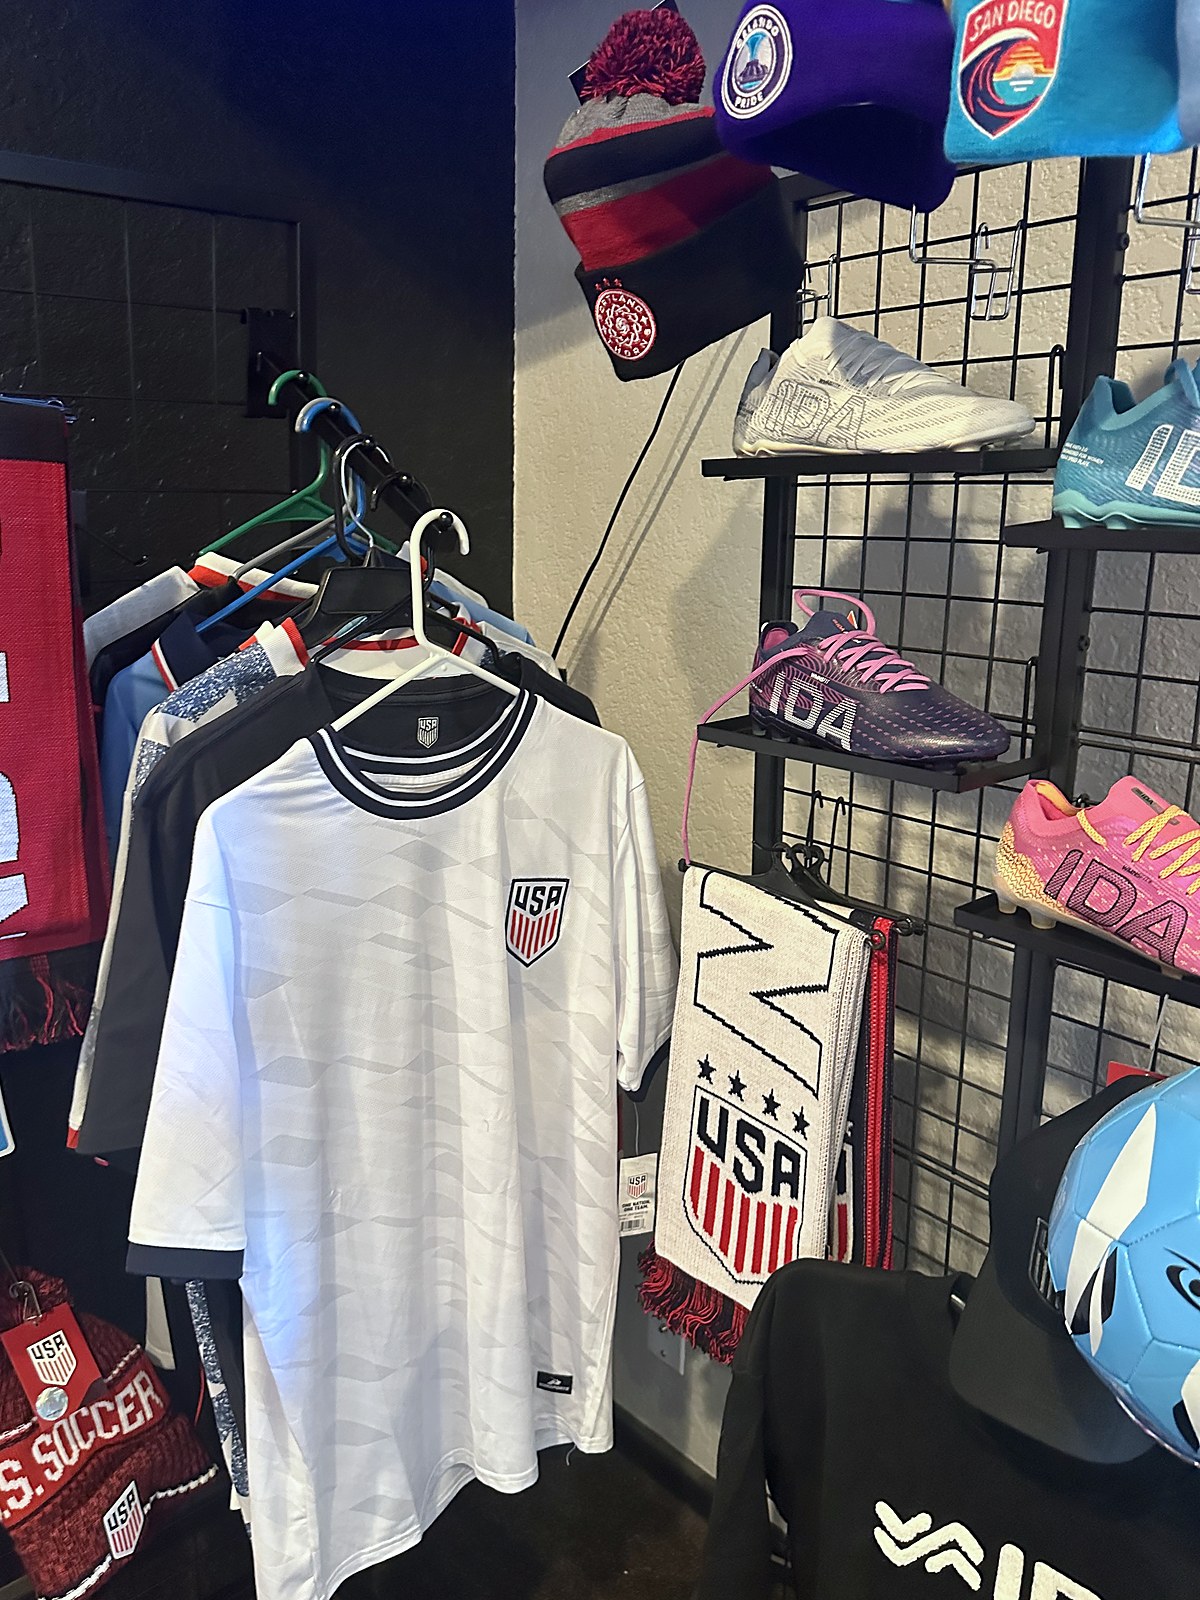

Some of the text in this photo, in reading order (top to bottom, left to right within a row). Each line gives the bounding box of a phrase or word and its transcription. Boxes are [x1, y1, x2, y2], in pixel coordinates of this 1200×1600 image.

[736, 17, 779, 49] ORLANDO
[969, 0, 1056, 42] SAN DIEGO
[735, 92, 764, 108] PRIDE
[765, 379, 866, 450] IDA
[420, 719, 437, 731] USA
[769, 671, 857, 751] IDA
[515, 886, 563, 916] USA
[1043, 848, 1188, 968] IDA
[697, 1096, 801, 1200] USA
[629, 1175, 646, 1185] USA
[32, 1333, 71, 1360] USA
[32, 1370, 164, 1482] SOCCER
[107, 1493, 135, 1532] USA
